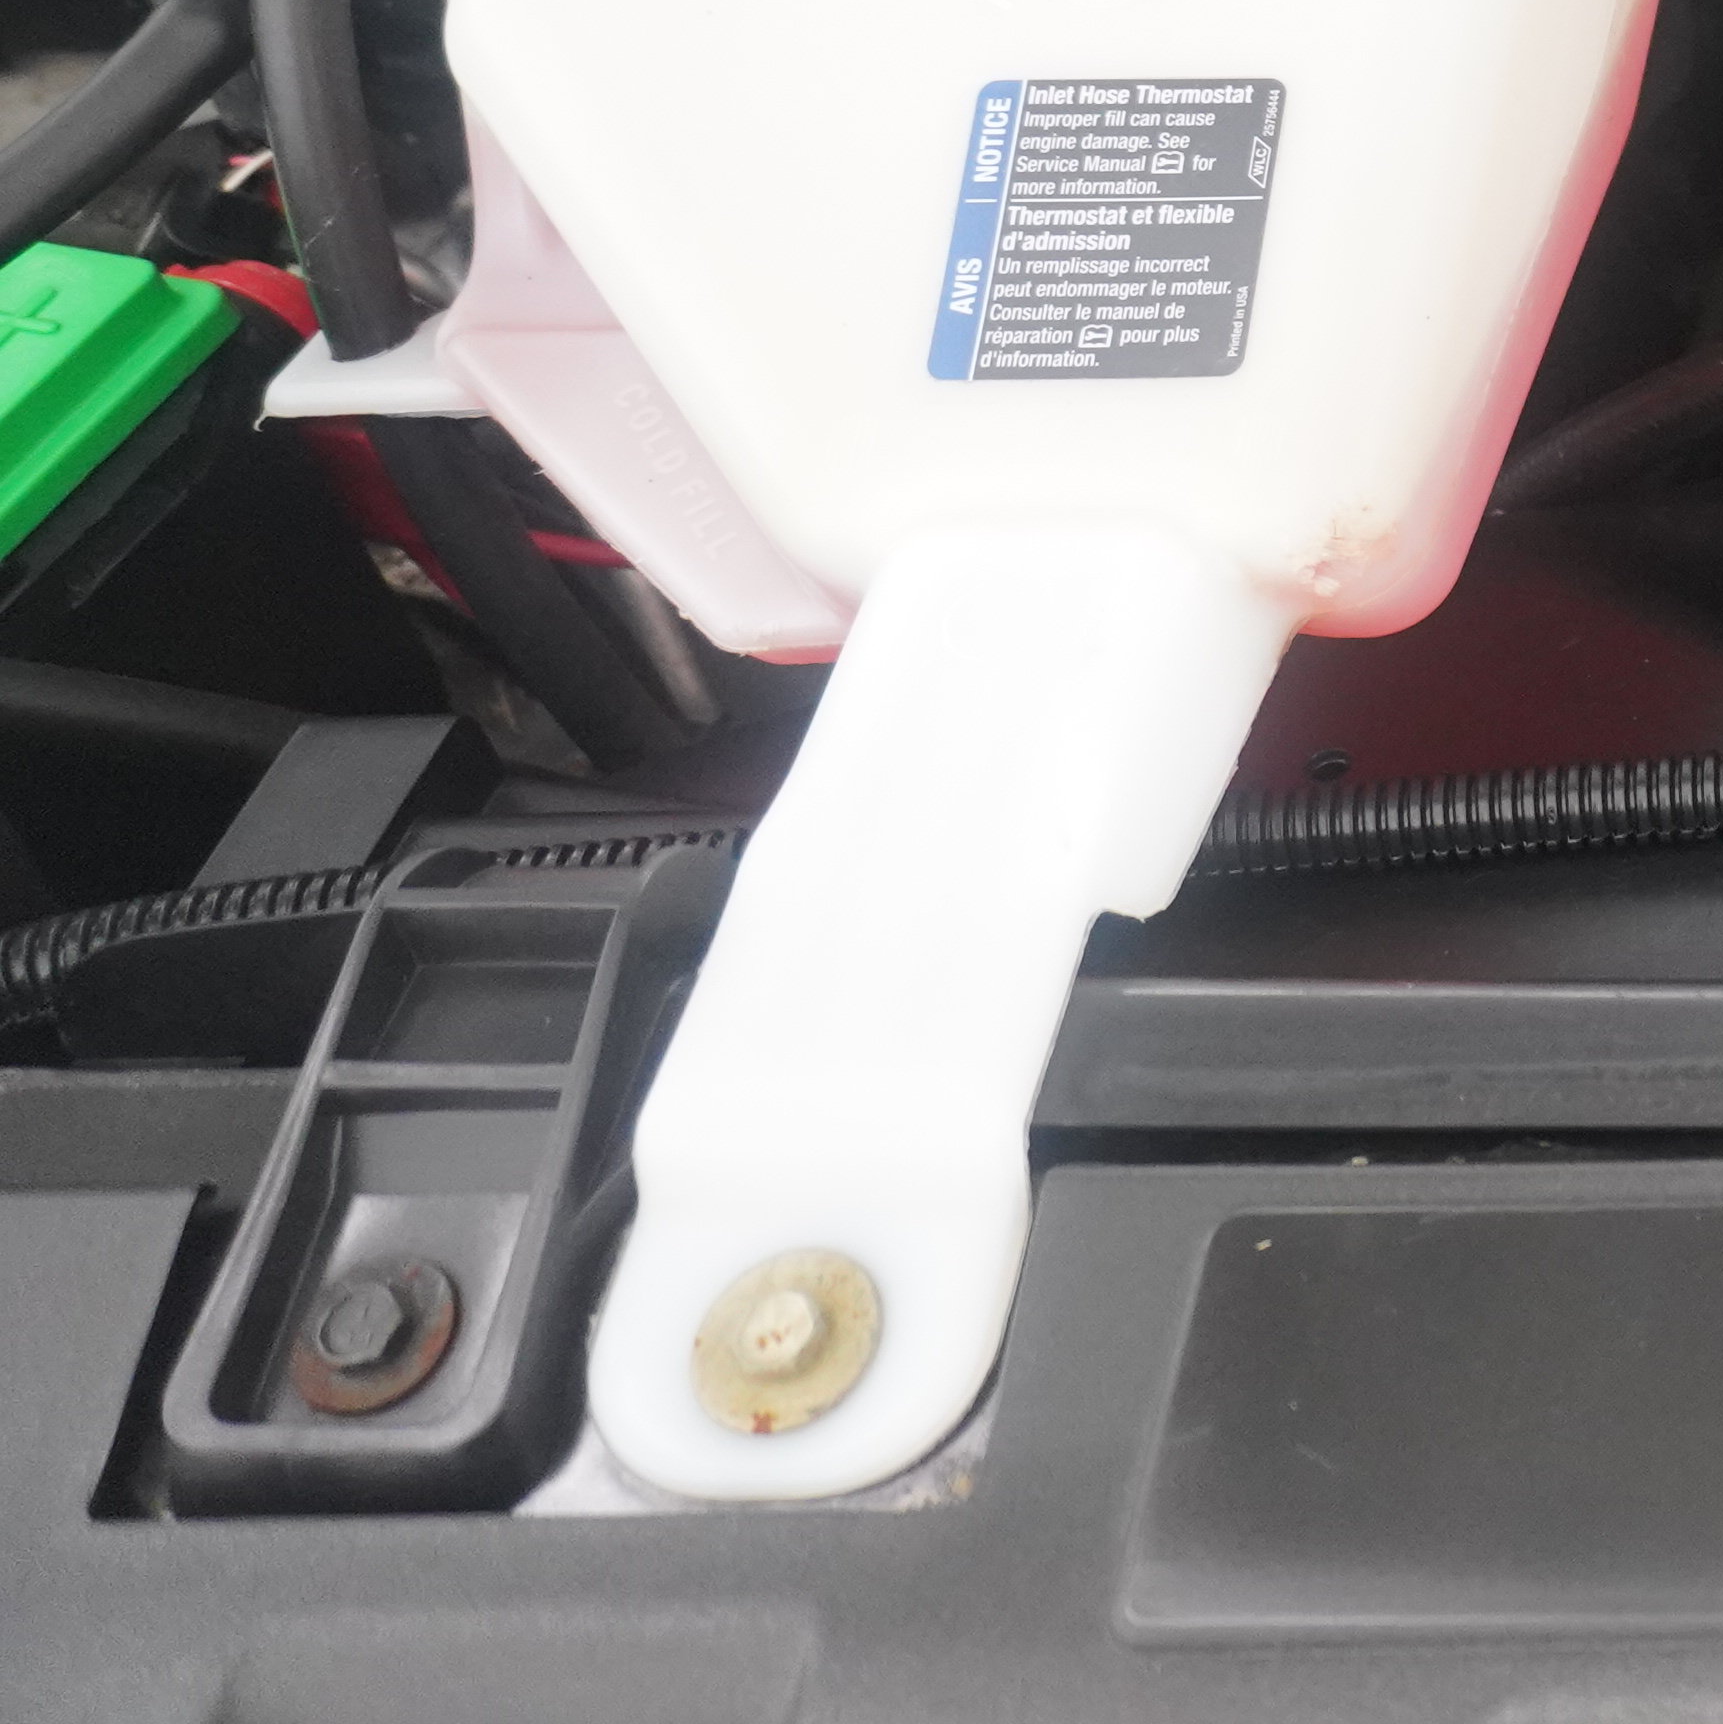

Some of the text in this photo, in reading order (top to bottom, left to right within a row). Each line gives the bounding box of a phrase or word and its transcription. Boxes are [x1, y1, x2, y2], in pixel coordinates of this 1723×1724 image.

[1028, 84, 1254, 105] Inlet Hose Thermostat
[1023, 110, 1216, 131] Improper fill can cause
[1263, 89, 1280, 136] 25756444
[973, 97, 1012, 182] NOTICE
[1020, 132, 1191, 154] engine damage. See
[1015, 154, 1217, 174] Service Manual for
[1253, 148, 1267, 176] WLC
[1011, 179, 1161, 196] more information.
[1008, 204, 1235, 226] Thermostat et flexible
[1002, 231, 1131, 251] d'admission
[998, 256, 1210, 278] Un remplissage incorrect
[950, 257, 983, 315] AVIS
[993, 279, 1232, 301] peut endommager le moteur.
[989, 303, 1185, 321] Consulter le manuel de
[1227, 286, 1249, 357] Printed in USA
[985, 325, 1200, 347] réparation pour plus
[980, 350, 1100, 368] d'information.
[613, 382, 738, 560] COLD FILL
